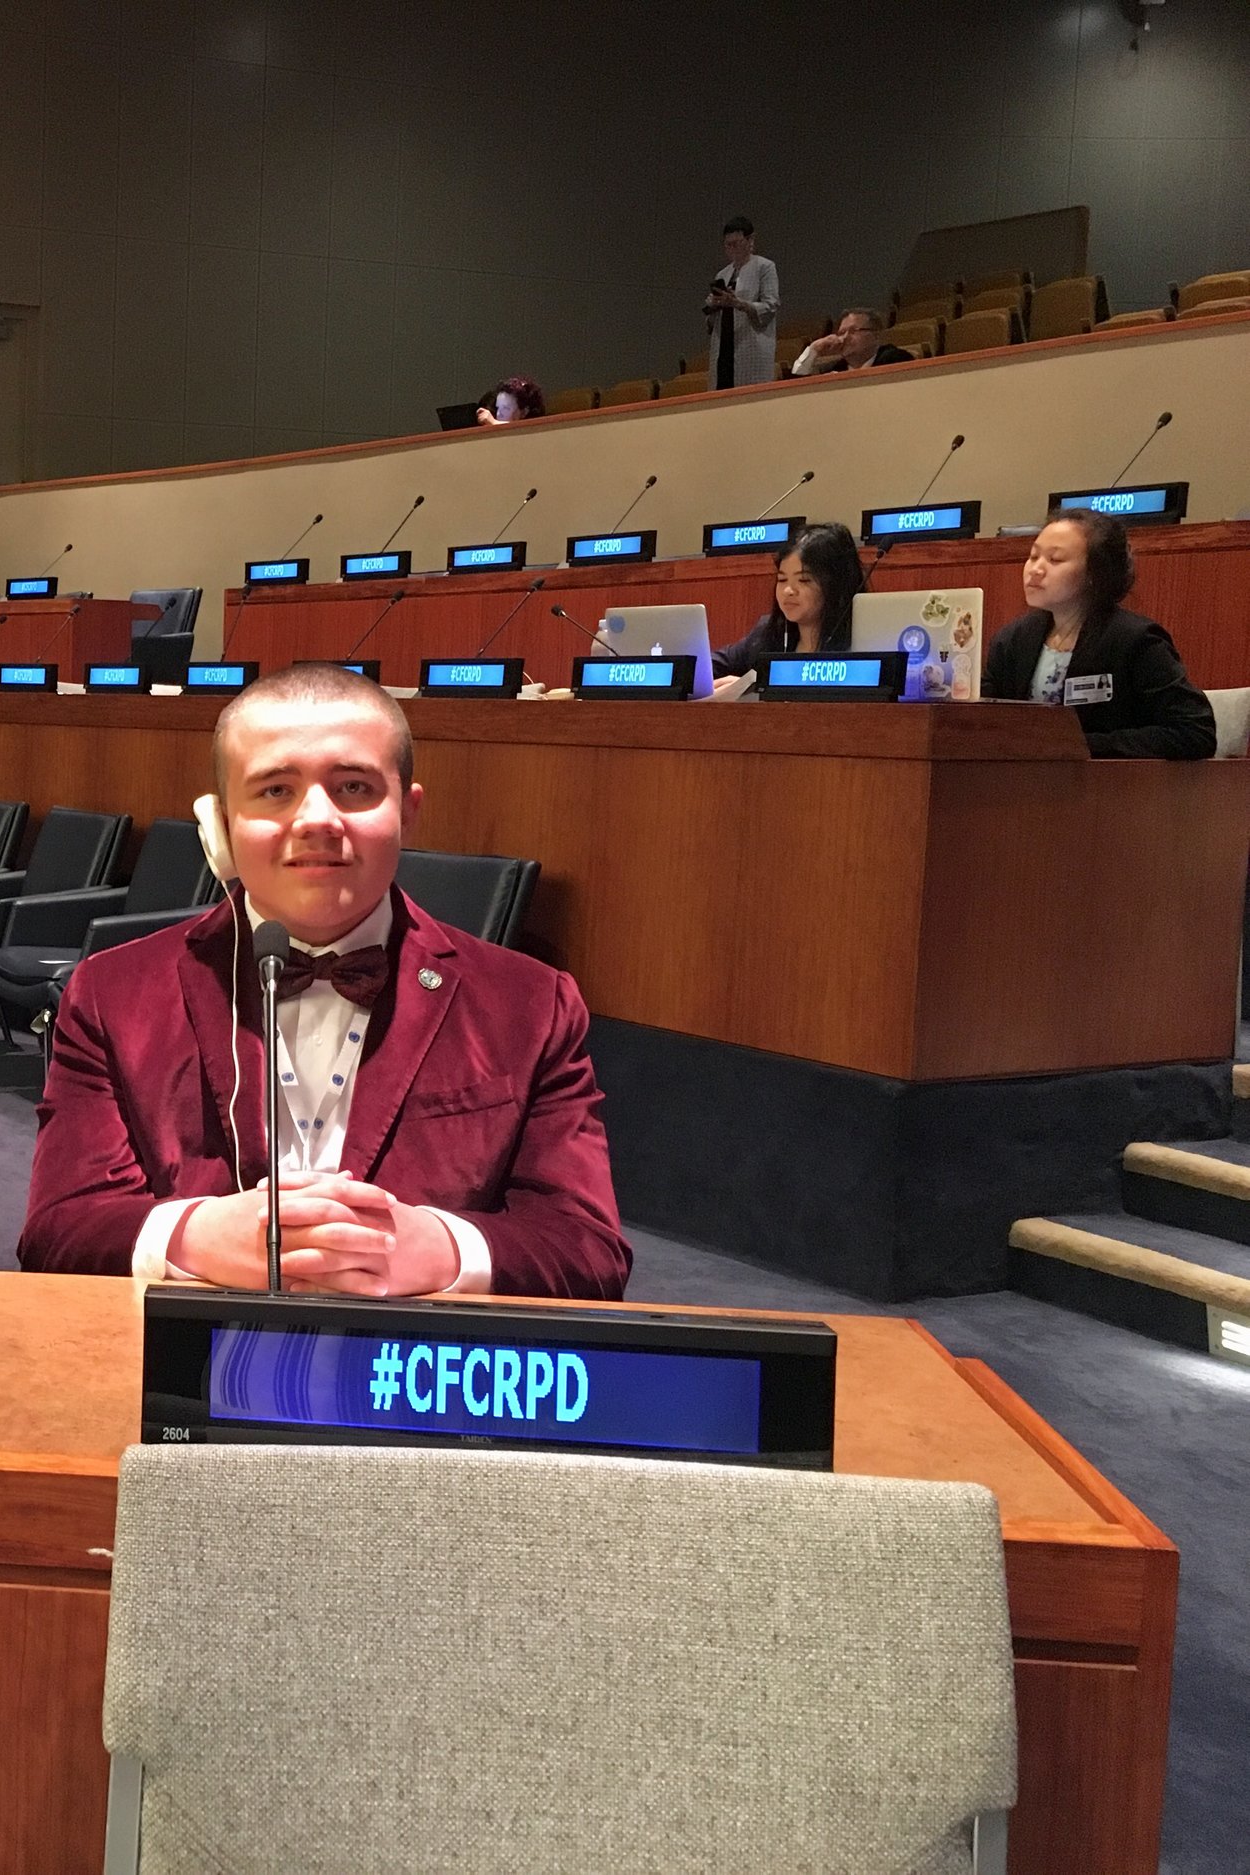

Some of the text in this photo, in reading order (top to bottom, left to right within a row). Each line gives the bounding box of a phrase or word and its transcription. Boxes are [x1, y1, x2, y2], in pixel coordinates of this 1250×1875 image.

[1091, 494, 1134, 513] #CFCRPD
[898, 512, 934, 529] #CFCRPD
[734, 527, 765, 542] #CFCRPD
[594, 539, 621, 553] #CFCRPD
[471, 549, 495, 563] #CFCRPD
[450, 666, 482, 682] #CFCRPD
[609, 665, 646, 683] #CFCRPD
[802, 662, 847, 681] #CFCRPD
[369, 1342, 588, 1422] #CFCRPD
[162, 1427, 190, 1441] 2604
